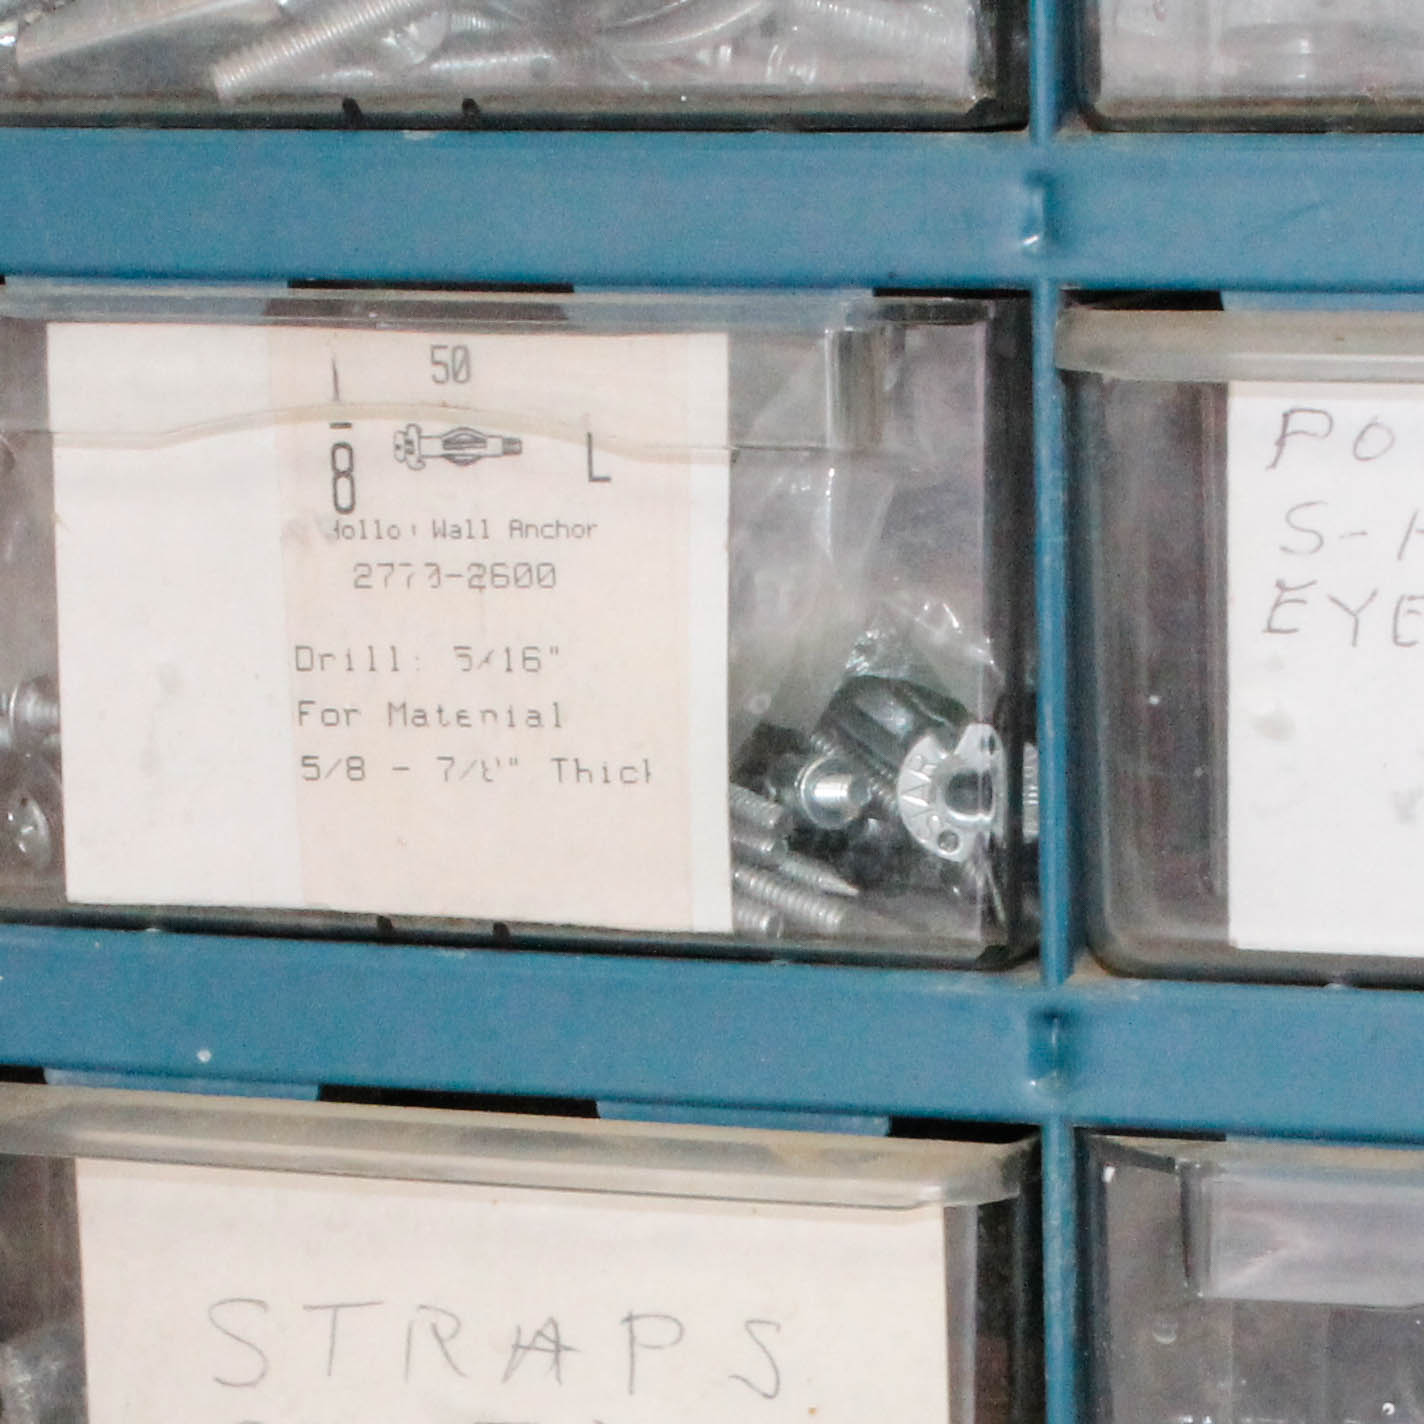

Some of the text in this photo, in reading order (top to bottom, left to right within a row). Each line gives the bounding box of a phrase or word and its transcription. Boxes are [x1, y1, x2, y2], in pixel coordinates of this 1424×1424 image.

[430, 344, 472, 385] 50
[586, 428, 612, 483] L
[330, 441, 356, 516] 8
[432, 519, 491, 540] Wall
[509, 519, 599, 541] Anchor
[295, 645, 421, 674] Drill:
[296, 700, 565, 729] For Material
[300, 755, 366, 783] 5/8
[207, 1297, 783, 1399] STRAPS
